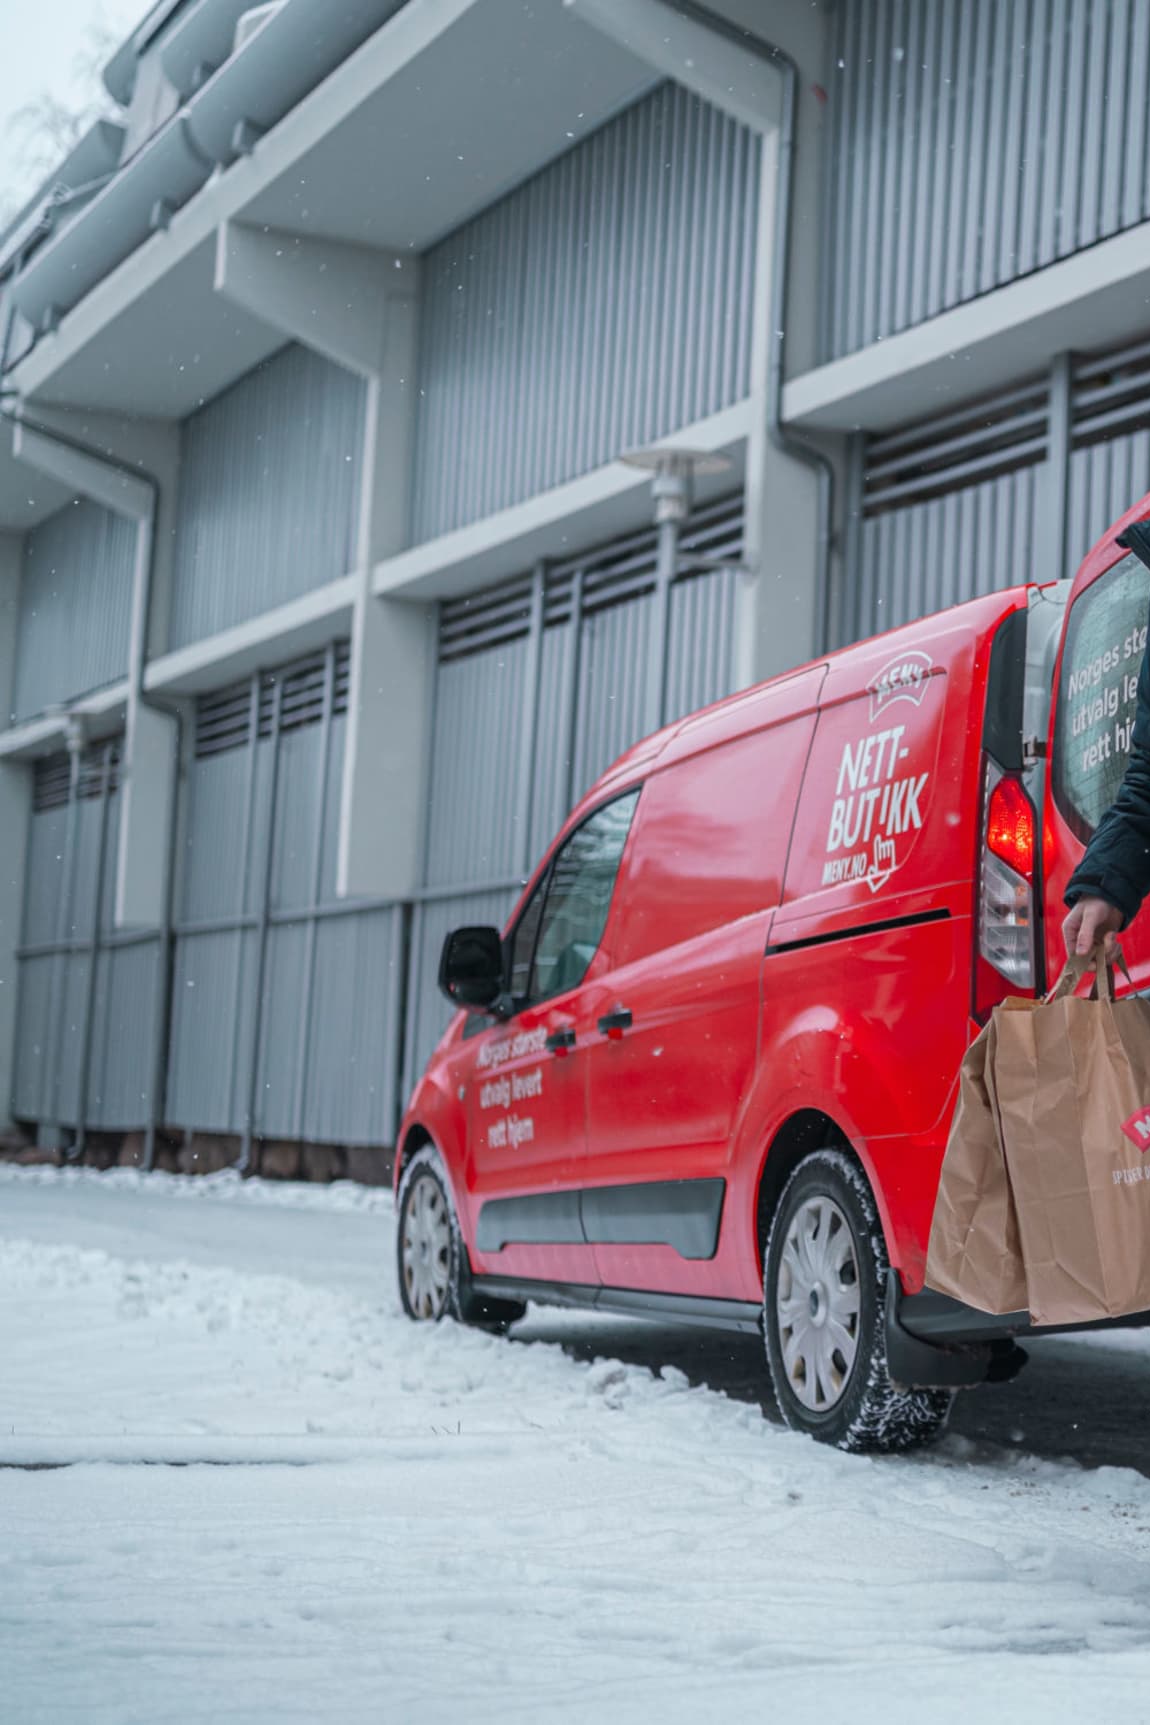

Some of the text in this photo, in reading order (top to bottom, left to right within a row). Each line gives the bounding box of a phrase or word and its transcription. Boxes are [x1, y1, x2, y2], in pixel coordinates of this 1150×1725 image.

[877, 664, 924, 704] MENY
[1068, 644, 1119, 699] Norges
[1071, 672, 1141, 737] utvalg le
[836, 725, 909, 796] NETT-
[1082, 731, 1111, 772] rett
[822, 852, 867, 886] MENY.NO
